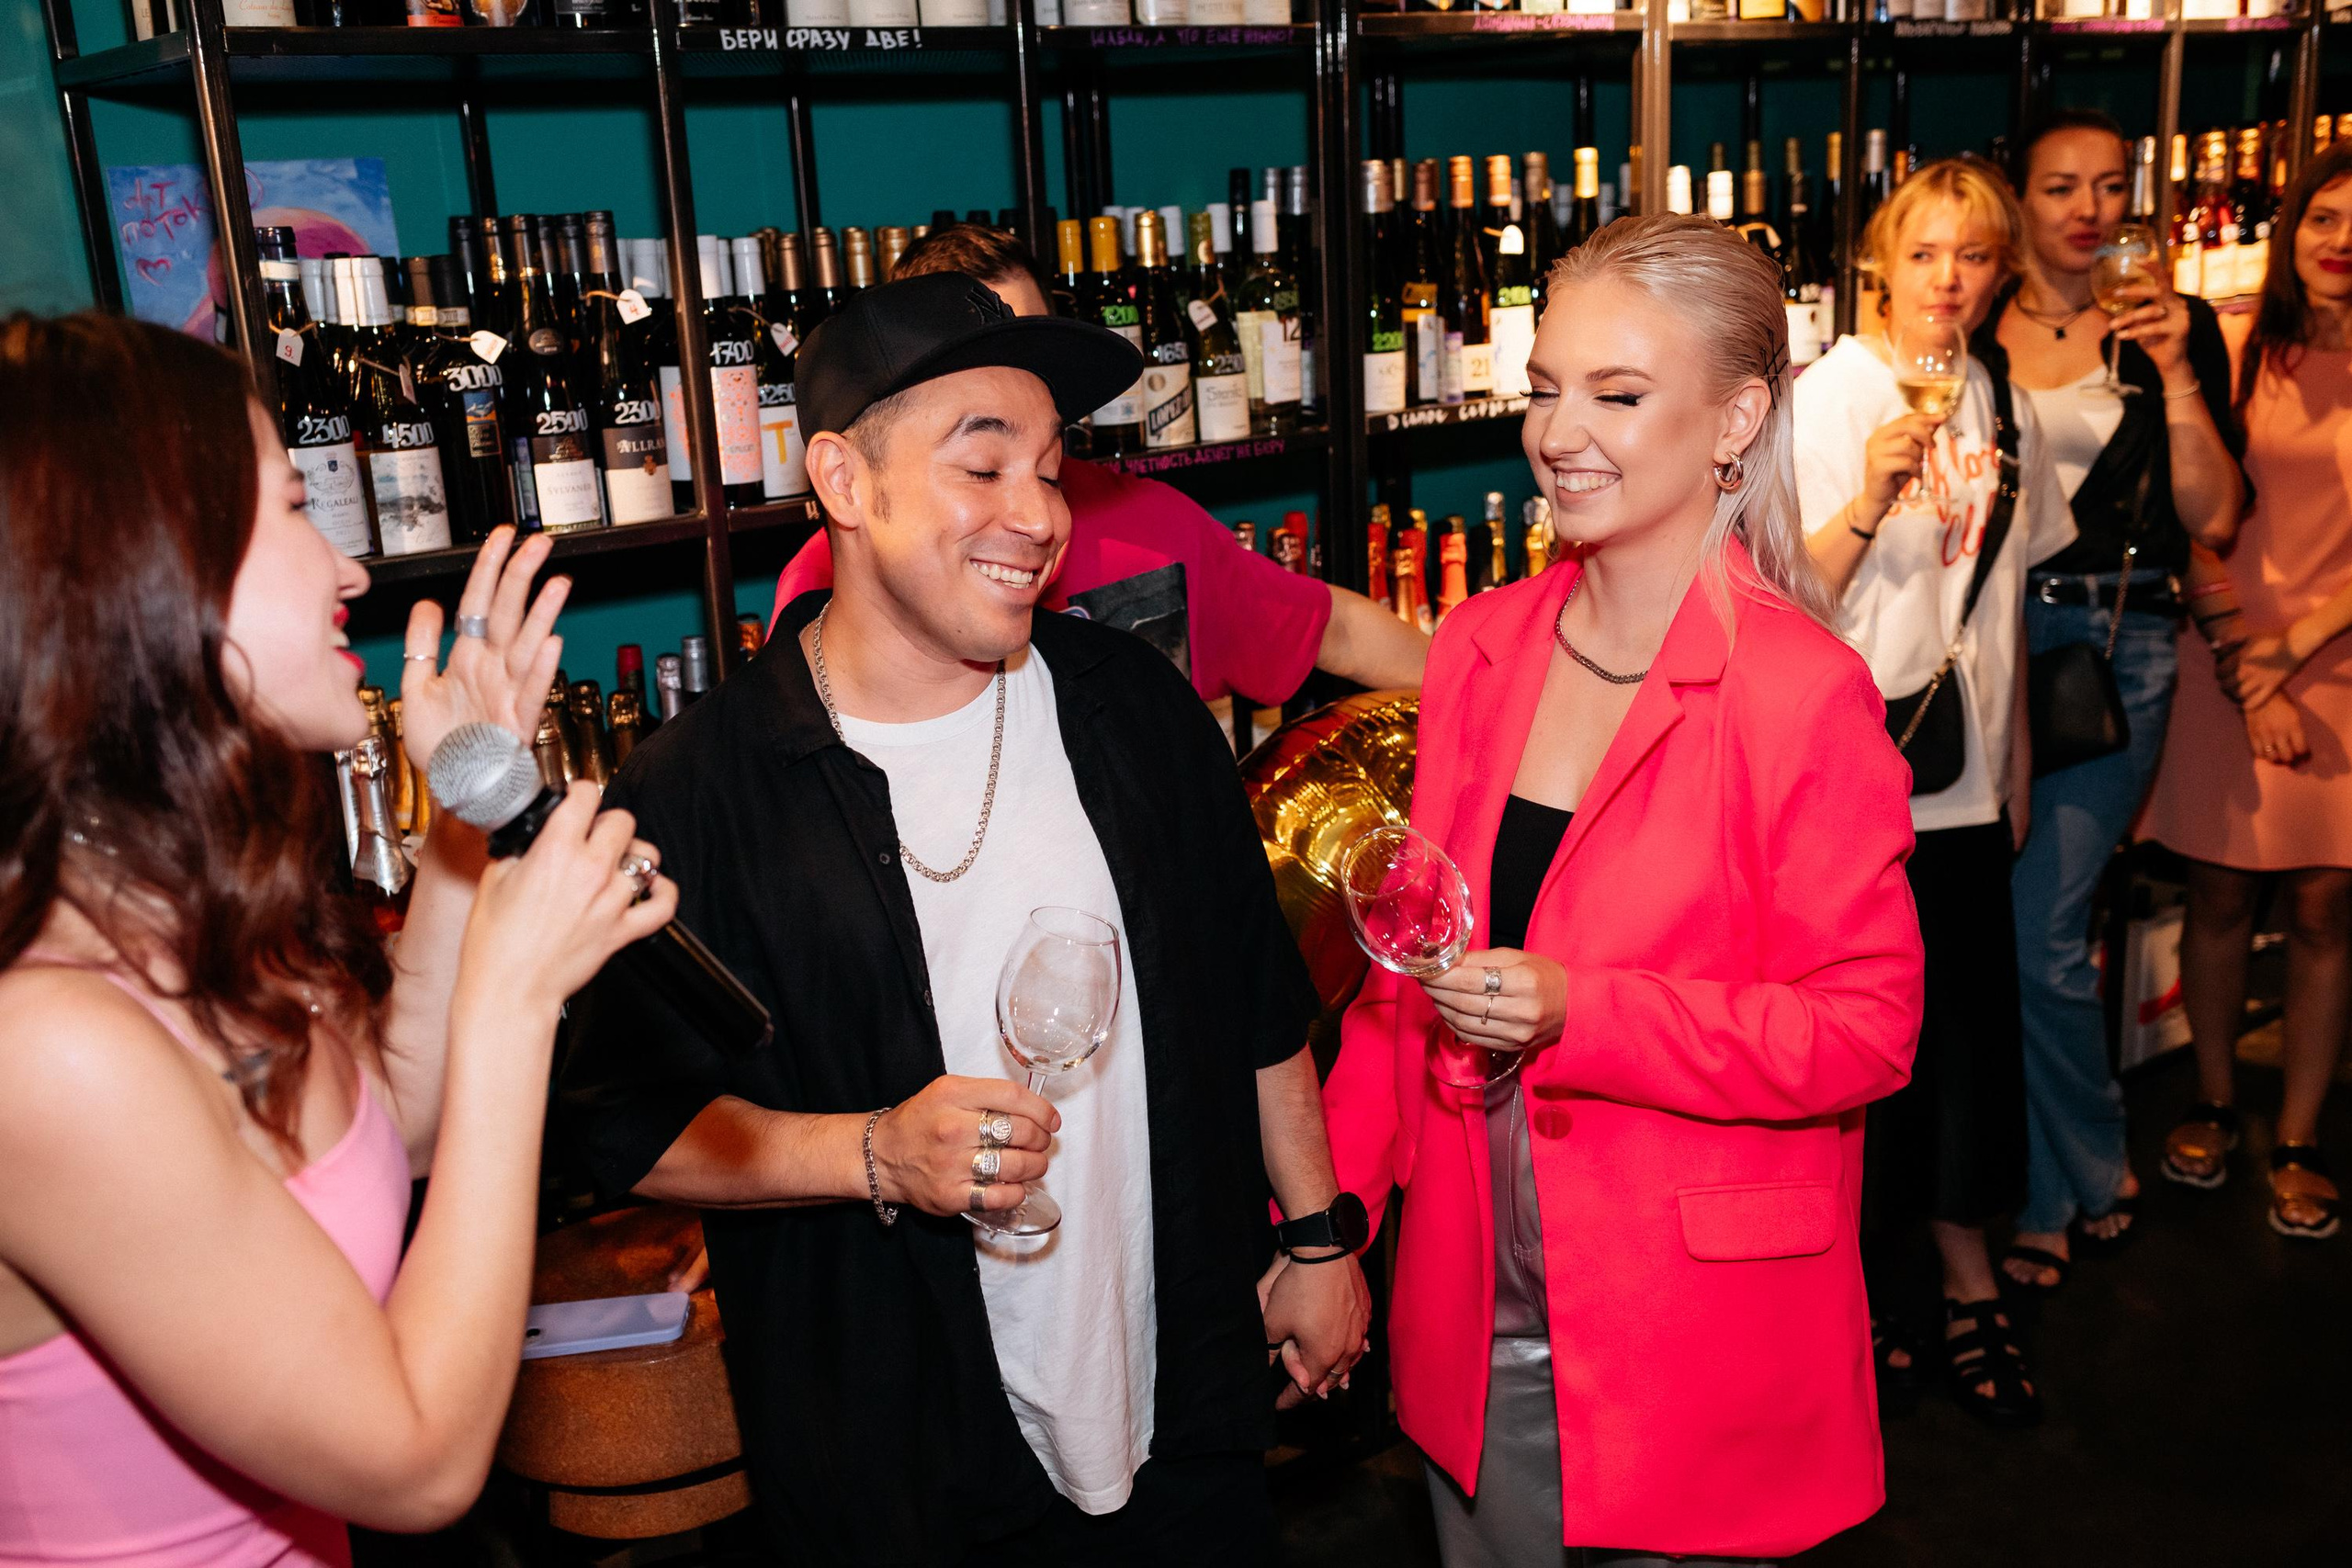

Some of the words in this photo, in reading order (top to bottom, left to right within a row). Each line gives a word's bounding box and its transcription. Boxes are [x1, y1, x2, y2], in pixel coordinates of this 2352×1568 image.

[719, 28, 779, 51] БЕРИ
[786, 28, 851, 51] СРАЗУ
[865, 28, 922, 50] ДВЕ!
[1176, 28, 1200, 44] ЧТО
[709, 339, 754, 366] 1700
[447, 364, 503, 392] 3000
[297, 414, 351, 445] 2300
[381, 421, 435, 449] 4500
[536, 408, 589, 435] 2500
[761, 419, 794, 465] T
[1195, 446, 1235, 465] ДЕНЕГ
[1237, 444, 1251, 457] НЕ
[1254, 439, 1285, 457] БЕРУ
